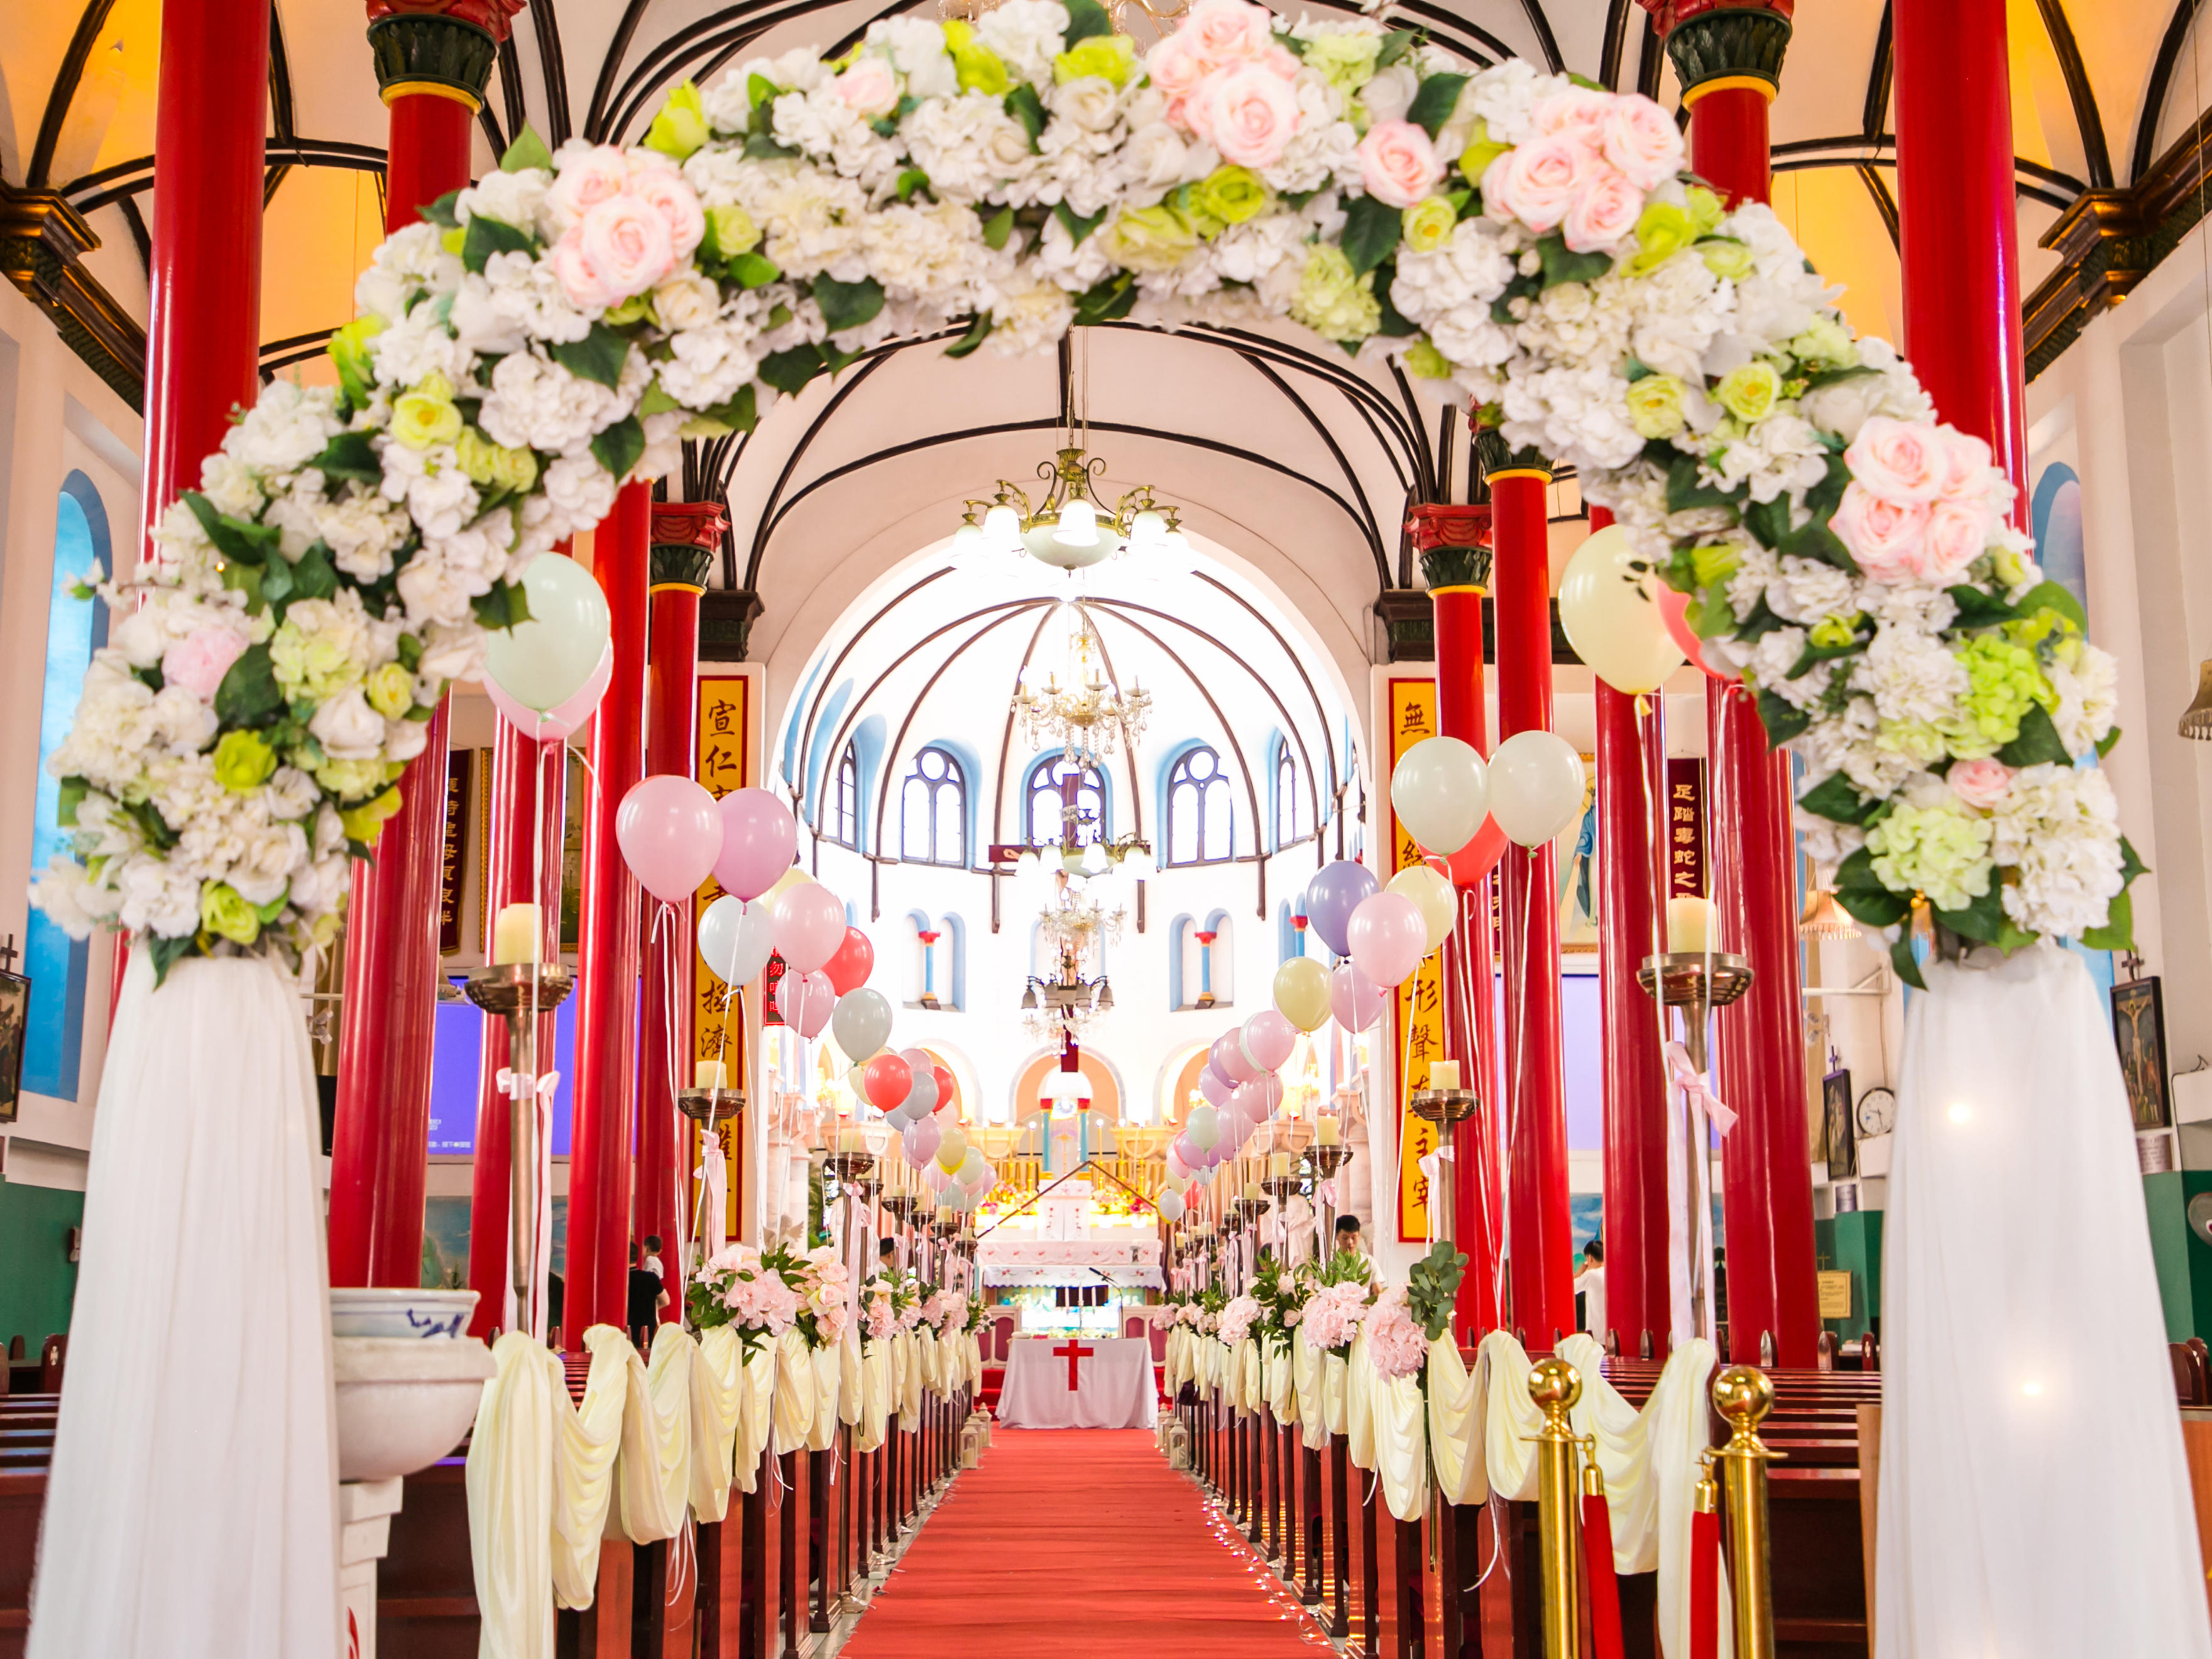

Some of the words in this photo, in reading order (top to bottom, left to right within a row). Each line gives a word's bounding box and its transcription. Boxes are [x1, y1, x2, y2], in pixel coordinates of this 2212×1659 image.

[1673, 784, 1696, 899] 足踏毒蛇之
